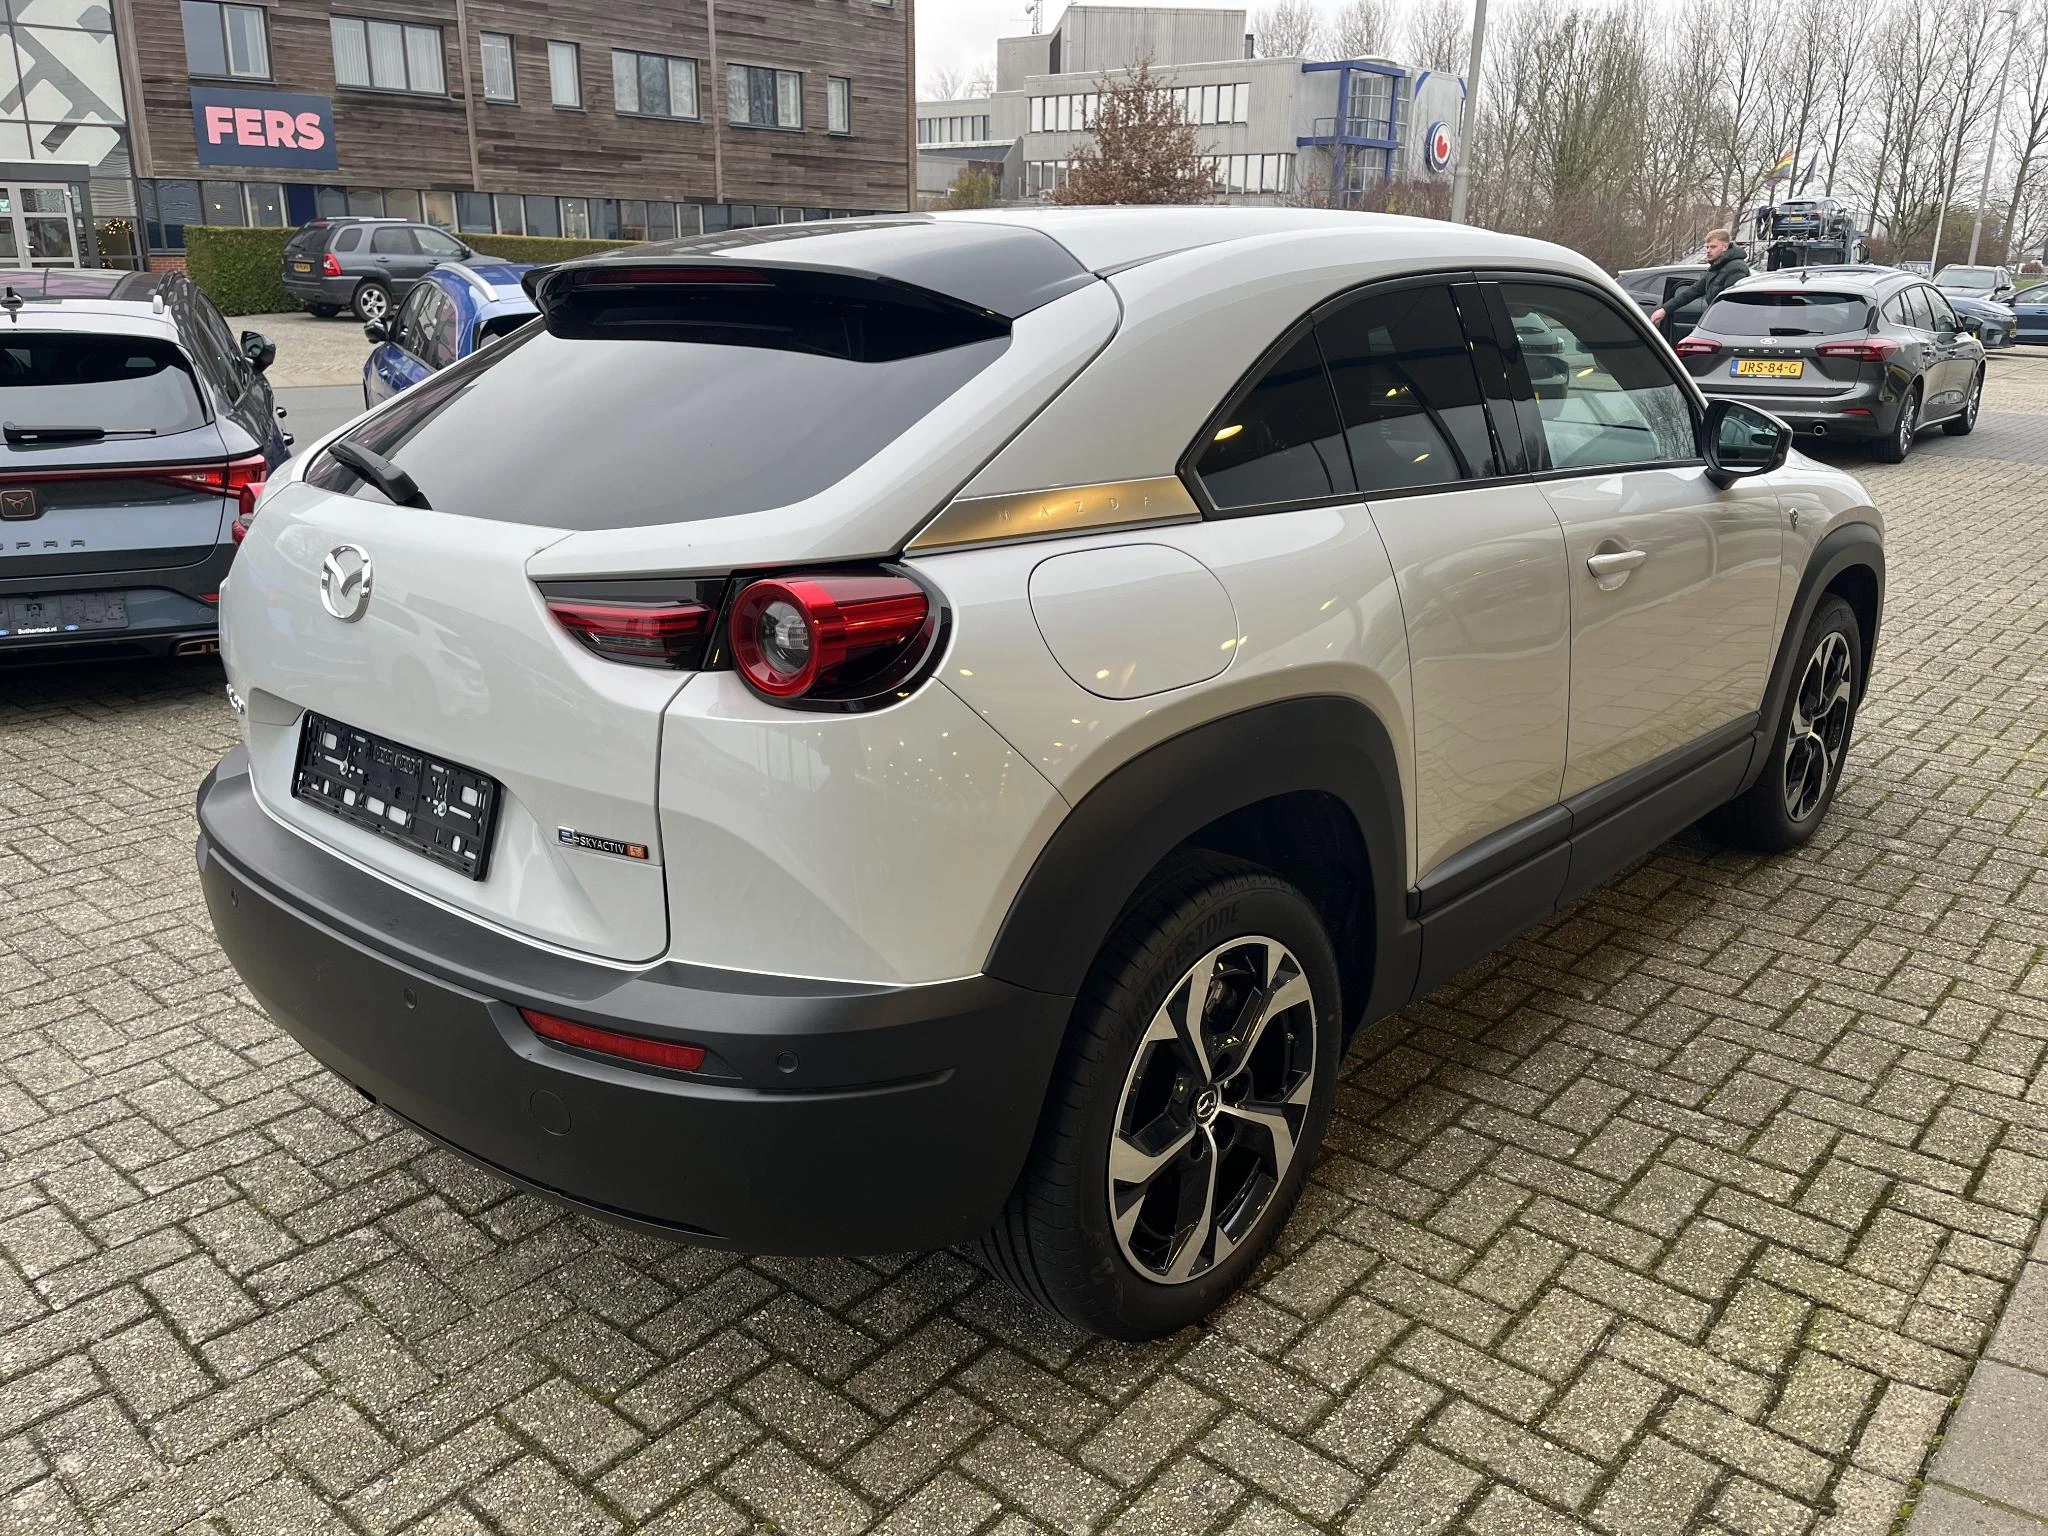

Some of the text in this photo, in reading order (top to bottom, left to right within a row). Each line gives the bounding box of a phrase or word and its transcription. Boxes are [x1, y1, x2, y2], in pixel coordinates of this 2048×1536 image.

[205, 106, 325, 150] FERS
[1740, 362, 1797, 374] JRS-84-G
[0, 540, 85, 550] PRA
